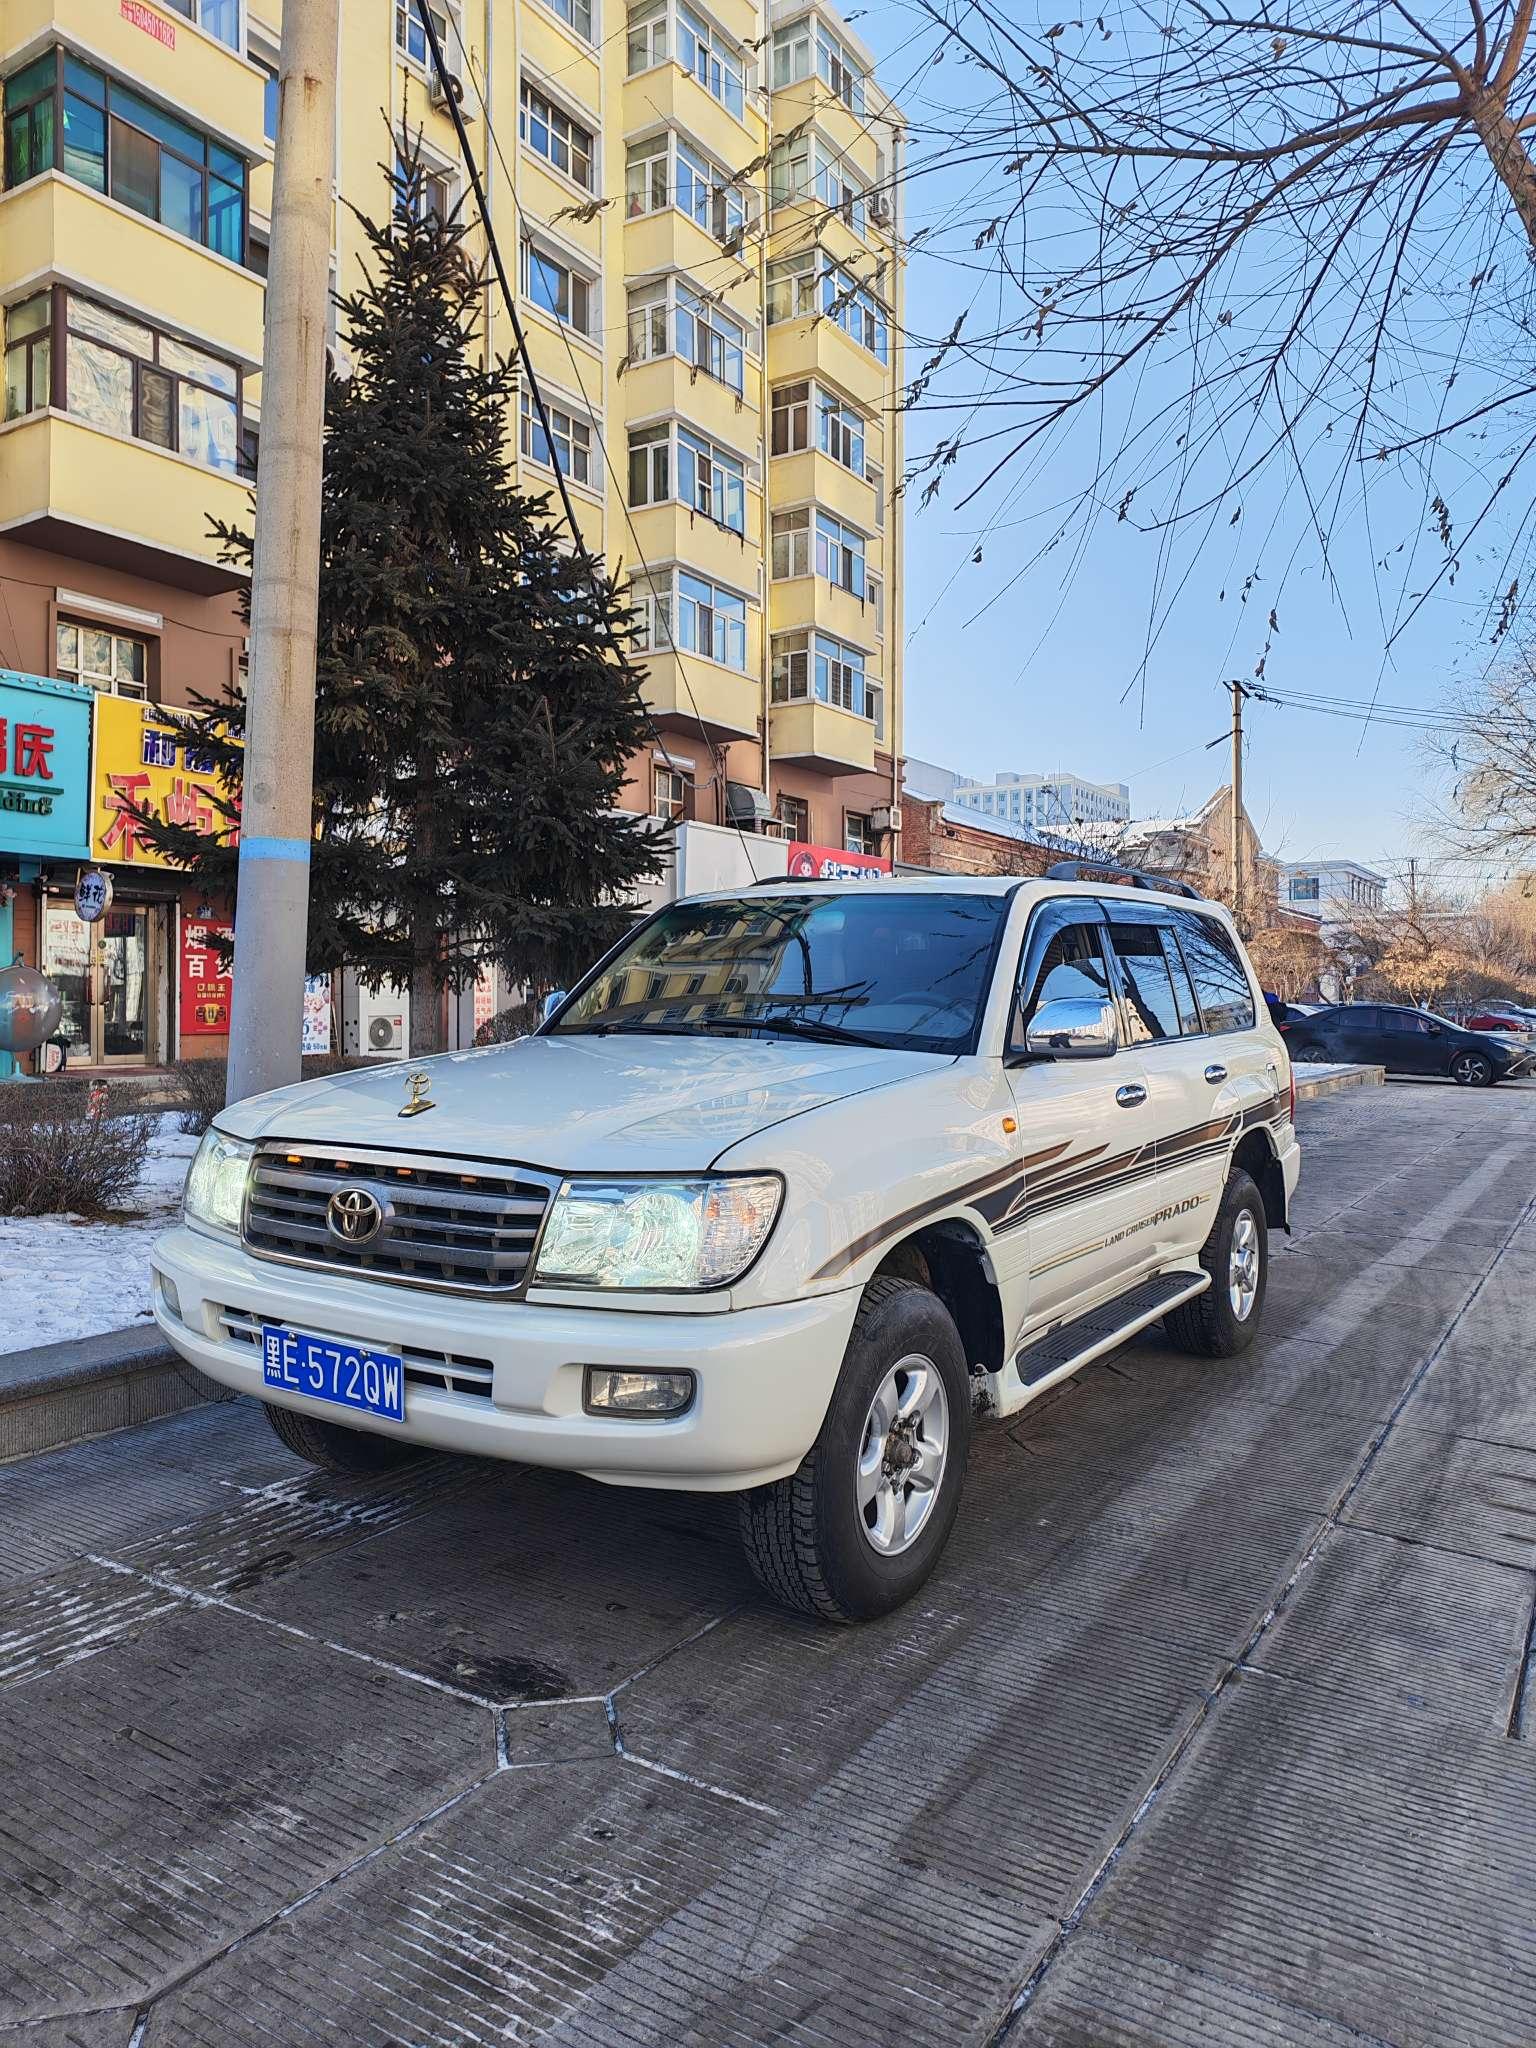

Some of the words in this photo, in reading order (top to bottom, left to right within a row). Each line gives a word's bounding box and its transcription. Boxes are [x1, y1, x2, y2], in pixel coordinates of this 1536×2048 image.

[1104, 1230, 1125, 1247] LAND
[1126, 1216, 1157, 1238] CRUISER
[1153, 1196, 1199, 1226] PRADO
